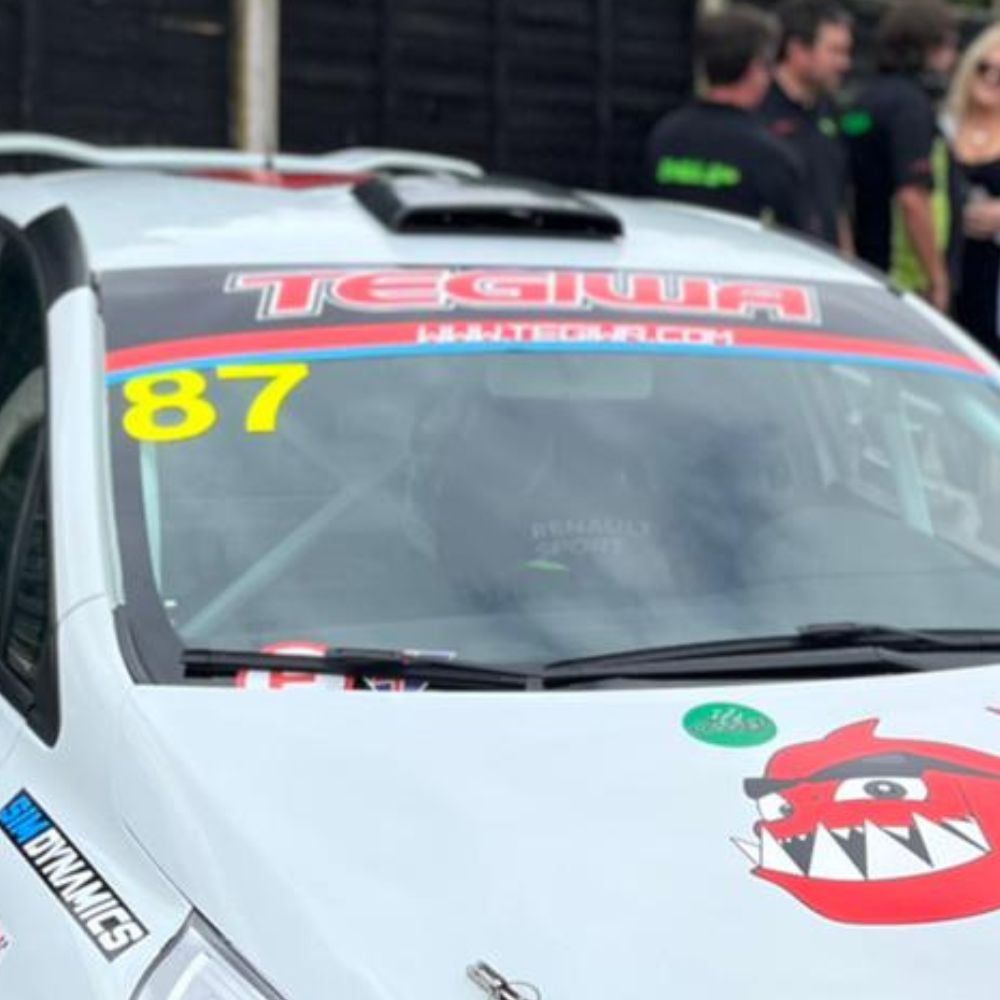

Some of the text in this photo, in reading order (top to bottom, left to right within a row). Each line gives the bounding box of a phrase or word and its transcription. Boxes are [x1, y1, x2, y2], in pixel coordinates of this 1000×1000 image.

[223, 268, 822, 325] TEGIWA
[416, 320, 735, 346] WWW.TEGIWA.COM
[122, 362, 310, 442] 87
[0, 794, 146, 951] SIM DYNAMICS
